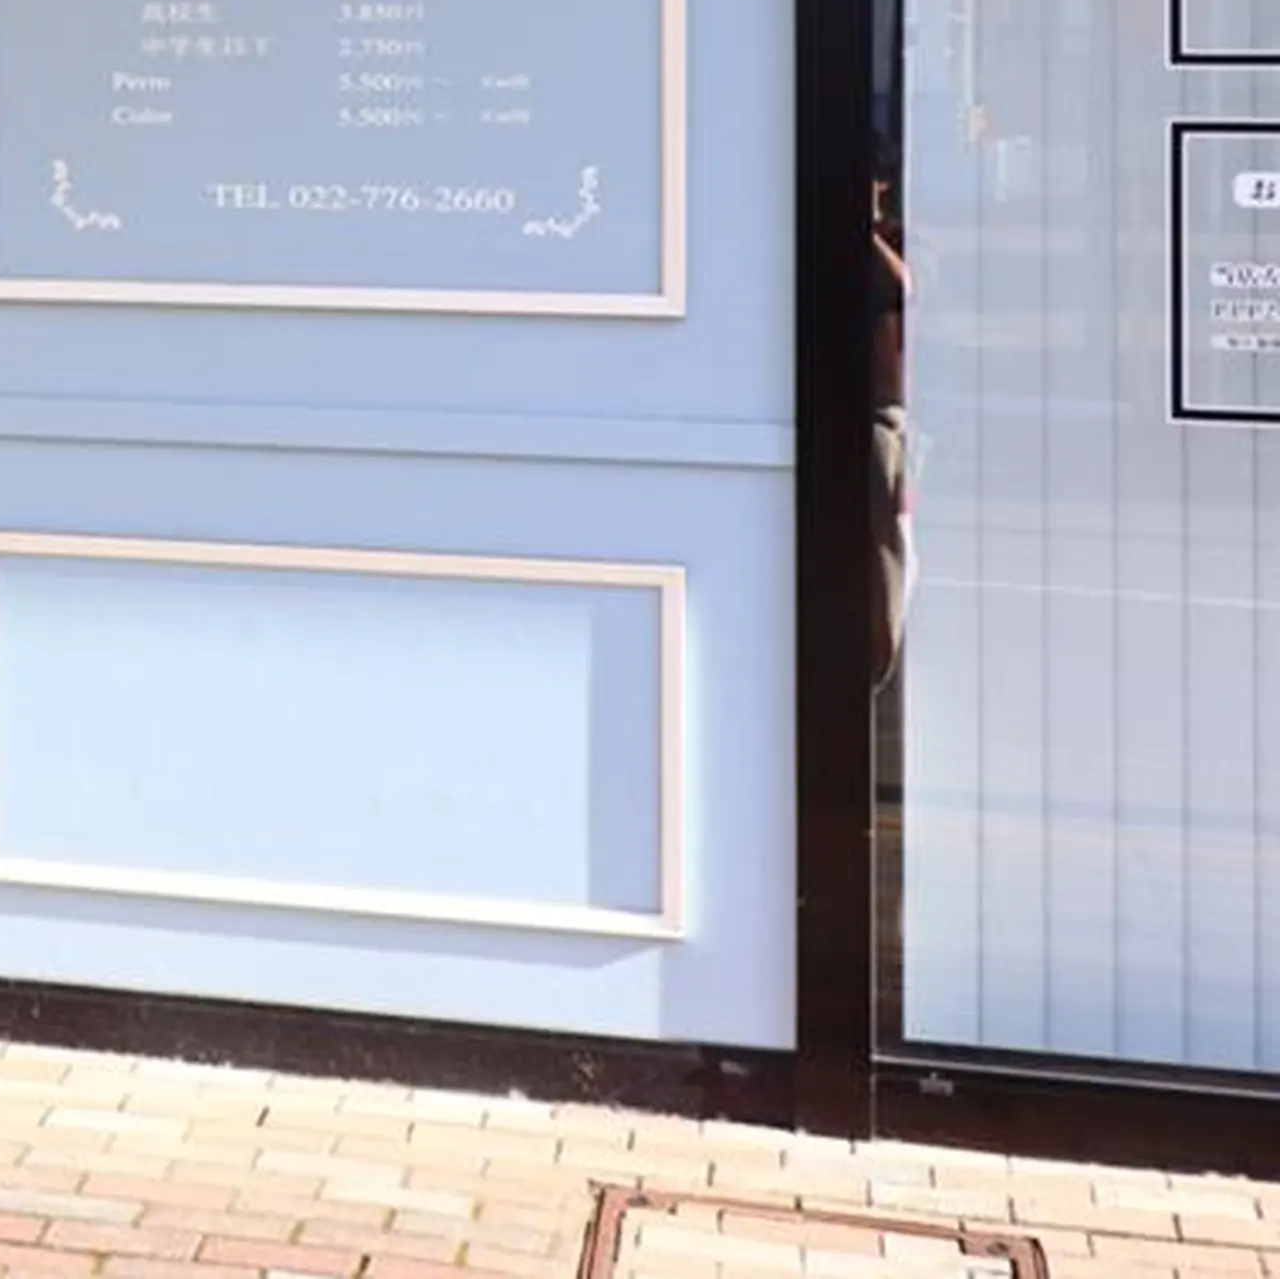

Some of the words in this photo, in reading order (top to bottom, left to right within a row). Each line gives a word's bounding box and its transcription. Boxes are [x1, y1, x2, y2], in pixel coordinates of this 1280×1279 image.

[112, 71, 172, 94] Perm
[206, 182, 279, 209] TEL
[288, 183, 517, 213] 022-776-2660
